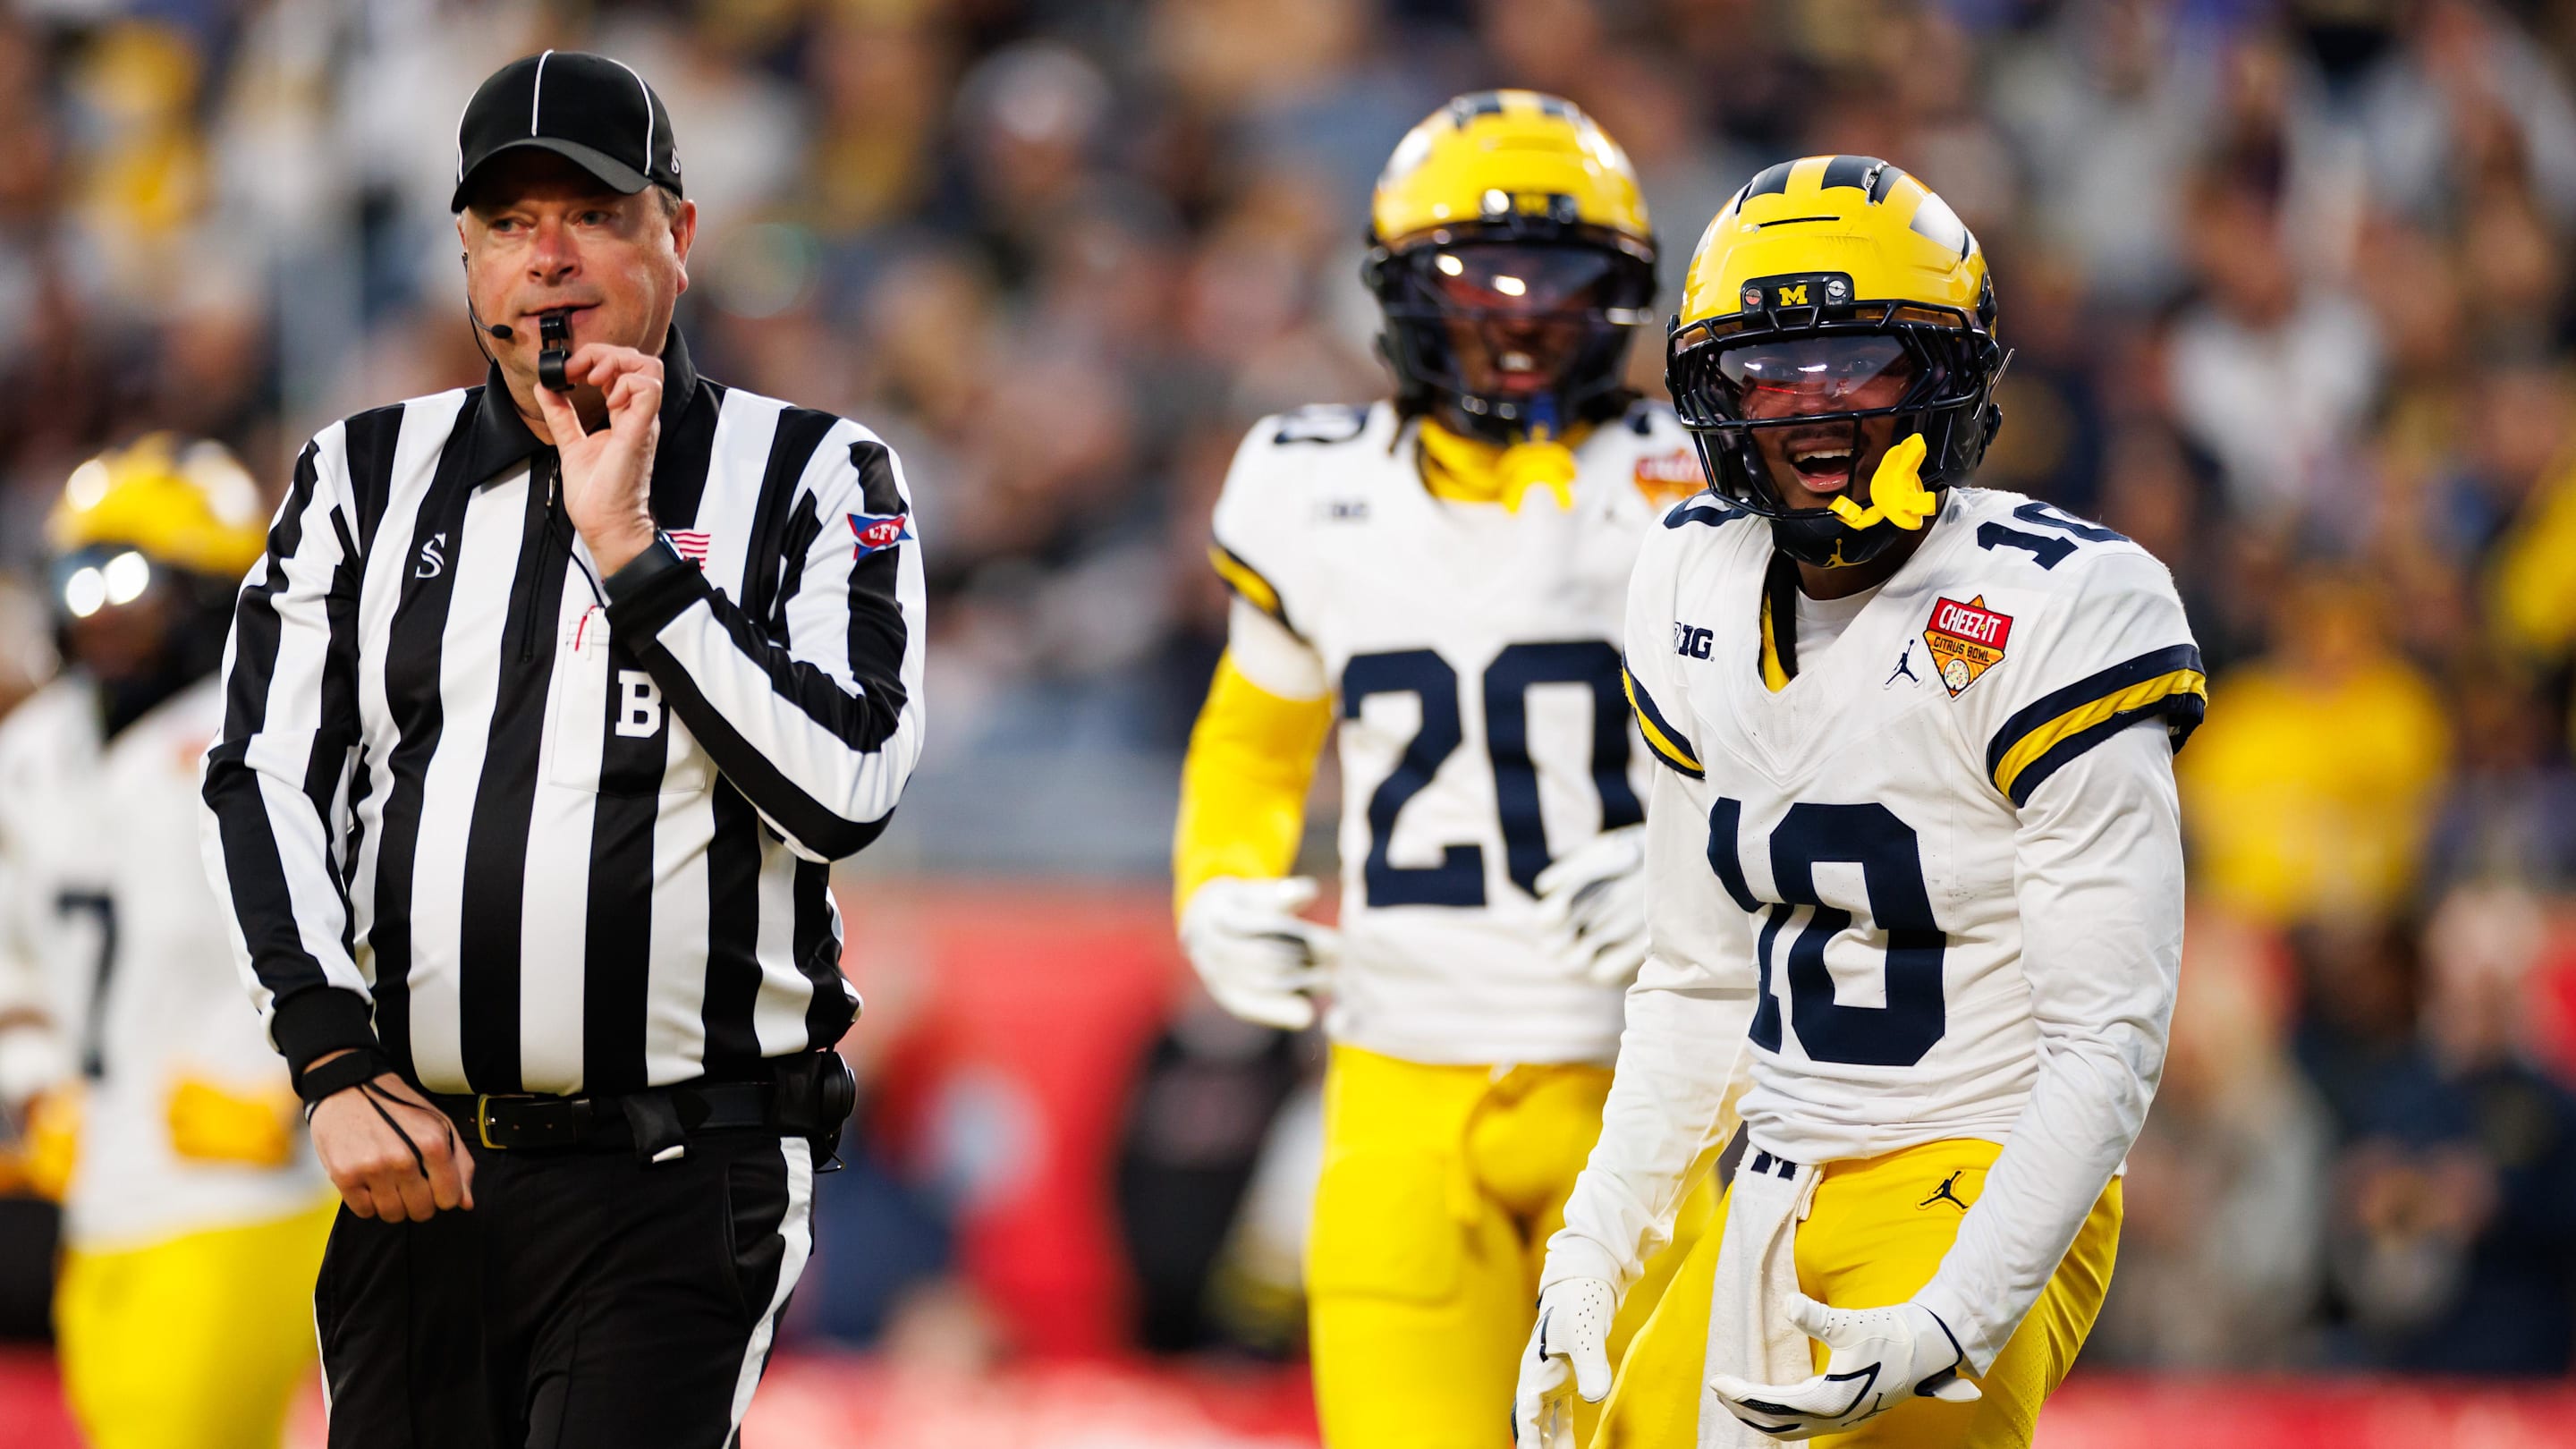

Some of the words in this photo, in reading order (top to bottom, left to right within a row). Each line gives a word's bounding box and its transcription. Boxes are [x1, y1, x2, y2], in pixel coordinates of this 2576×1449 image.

[1778, 284, 1809, 307] M
[1933, 636, 1965, 655] CITRUS
[1966, 646, 1990, 663] BOWL
[615, 670, 661, 738] B
[1343, 640, 1645, 907] 20
[1707, 796, 1946, 1067] 10
